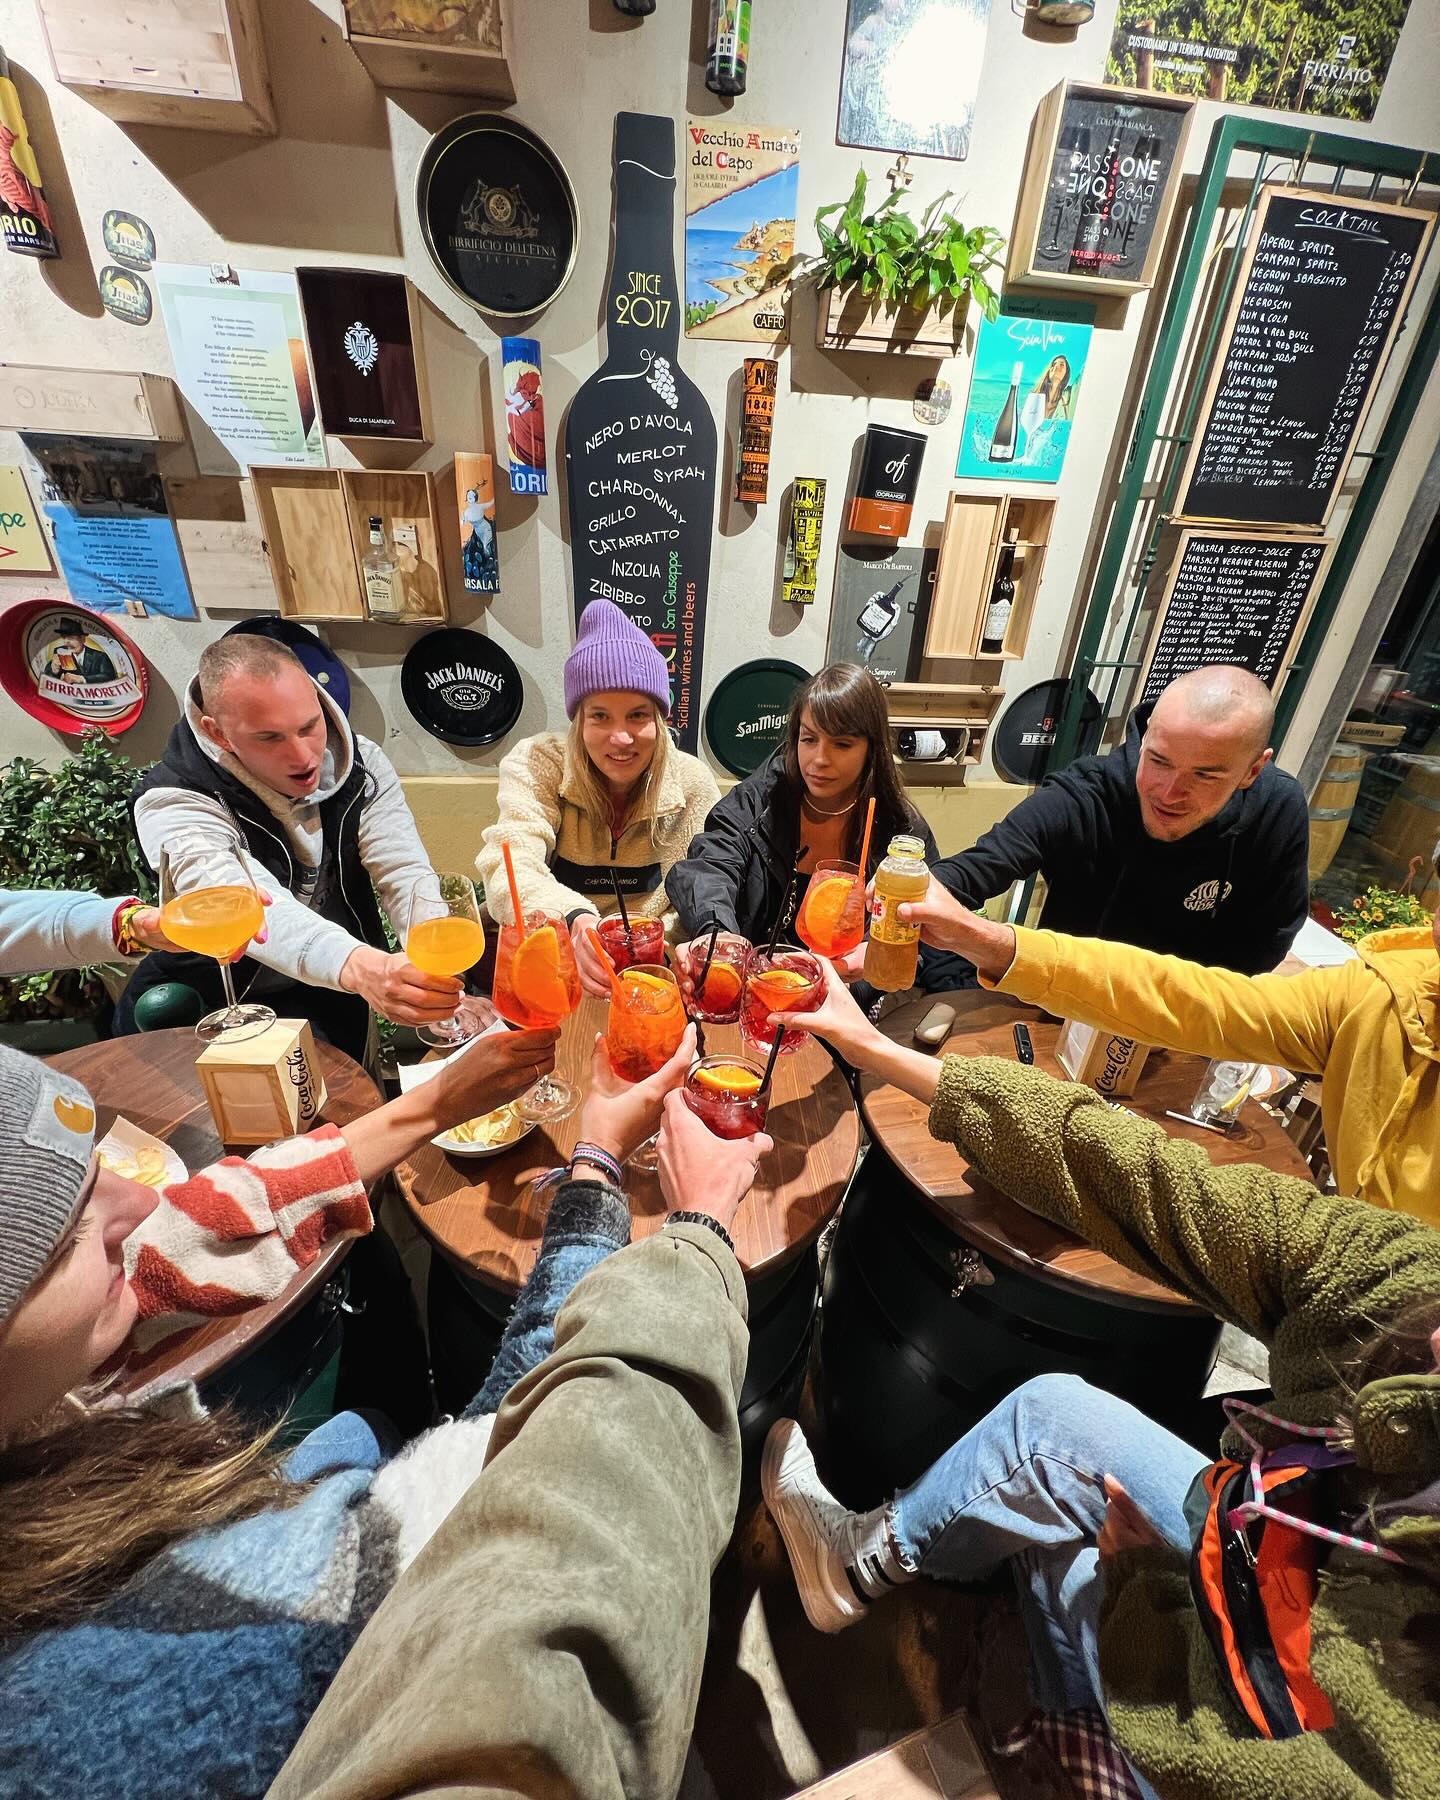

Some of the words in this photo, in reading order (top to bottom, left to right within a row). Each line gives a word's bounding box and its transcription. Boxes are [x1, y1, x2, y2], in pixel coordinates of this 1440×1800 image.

[1128, 35, 1168, 51] CUSTODIAMO
[1168, 41, 1179, 53] UN
[1179, 42, 1204, 57] TERROIR
[1204, 47, 1238, 62] AUTENTICO
[1302, 60, 1373, 84] FIRRIATO
[689, 128, 744, 148] Vecchio
[746, 133, 798, 154] Amaro
[692, 151, 712, 167] del
[716, 152, 753, 173] Capo
[1300, 208, 1382, 233] COCKTAIL
[1260, 233, 1295, 250] APEROL
[1299, 241, 1335, 256] SPRITZ
[1251, 267, 1290, 281] NEGRONI
[1294, 273, 1347, 286] SBAGLIATO
[1255, 253, 1300, 267] CAMPARI
[1305, 258, 1338, 271] SPRITZ
[1382, 268, 1406, 280] 7,50
[628, 272, 661, 295] SINCE
[1248, 282, 1284, 295] NEGRONI
[615, 295, 671, 328] 2017
[755, 314, 785, 329] CAFFO
[1240, 310, 1257, 321] RUM
[1267, 314, 1288, 324] COLA
[1237, 325, 1260, 335] VODKA
[1271, 327, 1286, 338] RED
[1288, 329, 1309, 341] BULL
[1230, 348, 1269, 360] CAMPARI
[1272, 352, 1297, 363] SODA
[1233, 336, 1262, 348] APEROL
[1275, 339, 1290, 351] RED
[1293, 342, 1315, 353] BULL
[1353, 349, 1373, 360] 6,50
[1227, 361, 1275, 373] AMERICANO
[1346, 373, 1365, 384] 7,50
[748, 399, 773, 412] 1845
[1219, 386, 1251, 398] LONDON
[1254, 389, 1275, 401] MULE
[1336, 397, 1358, 408] 7,00
[1217, 400, 1247, 411] MOSCOW
[1249, 403, 1270, 414] MULE
[1332, 408, 1354, 420] 7,00
[1210, 423, 1257, 436] TANQUERAY
[1213, 411, 1245, 425] BOMBAY
[1277, 416, 1306, 428] LEMON
[1328, 421, 1351, 433] 7,50
[586, 422, 623, 454] NERO
[630, 415, 693, 435] D'AVOLA
[617, 445, 686, 464] MERLOT
[1221, 445, 1240, 454] MARE
[654, 466, 705, 484] SYRAH
[589, 478, 687, 525] CHARDONNAY
[589, 505, 636, 532] GRILLO
[589, 529, 680, 556] CATARRATTO
[1189, 542, 1224, 554] MARSALA
[1301, 547, 1321, 559] 6,50
[611, 559, 661, 578] INZOLIA
[1182, 564, 1216, 574] MARSALA
[1219, 567, 1247, 576] VECCHIO
[1184, 554, 1219, 565] MARSALA
[1297, 560, 1314, 571] 9,00
[663, 550, 683, 606] Giuseppe
[1176, 582, 1204, 591] PASSITO
[1179, 572, 1212, 583] MARSALA
[1216, 576, 1244, 585] RUBINO
[1287, 580, 1307, 590] 9,00
[590, 579, 646, 605] ZIBIBBO
[682, 582, 697, 619] beers
[1173, 592, 1199, 601] PASSITO
[662, 609, 677, 630] San
[682, 622, 694, 647] and
[425, 667, 456, 690] JACK
[455, 662, 505, 693] DANIEL'S
[680, 651, 693, 685] wines
[677, 688, 690, 729] Sicilian
